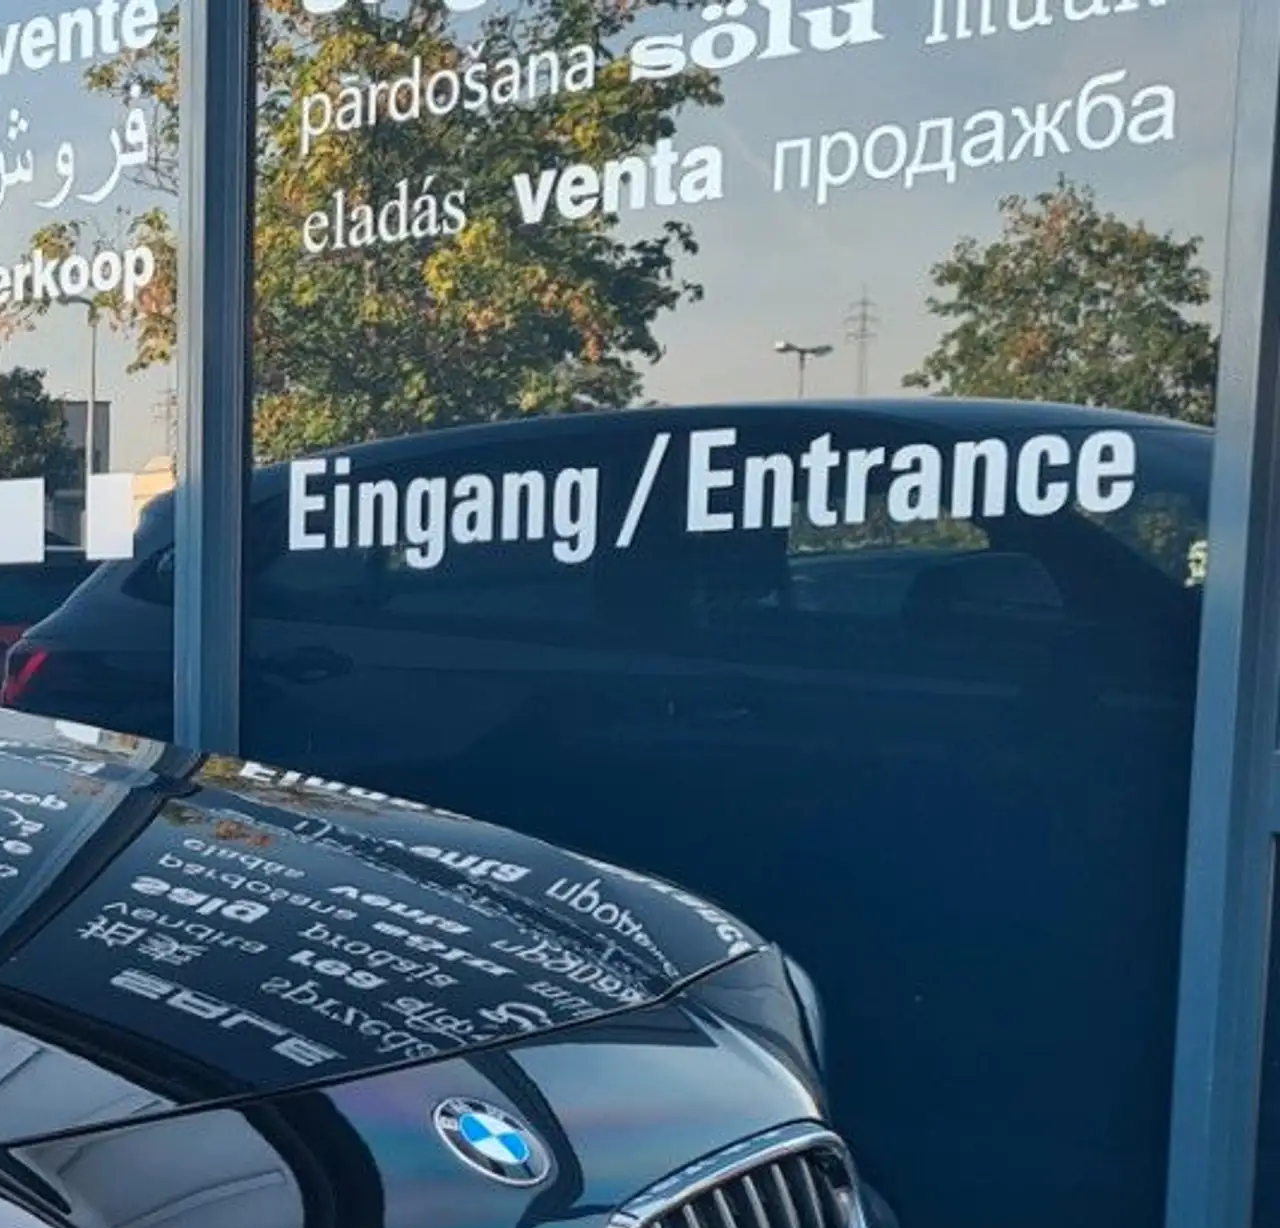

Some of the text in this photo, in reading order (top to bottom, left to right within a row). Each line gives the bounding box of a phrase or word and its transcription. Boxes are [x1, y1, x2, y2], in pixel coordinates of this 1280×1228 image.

[300, 44, 595, 156] pārdošana
[772, 68, 1176, 206] продажба
[300, 137, 724, 255] eladás venta
[288, 458, 600, 571] Eingang
[685, 427, 1136, 533] Entrance
